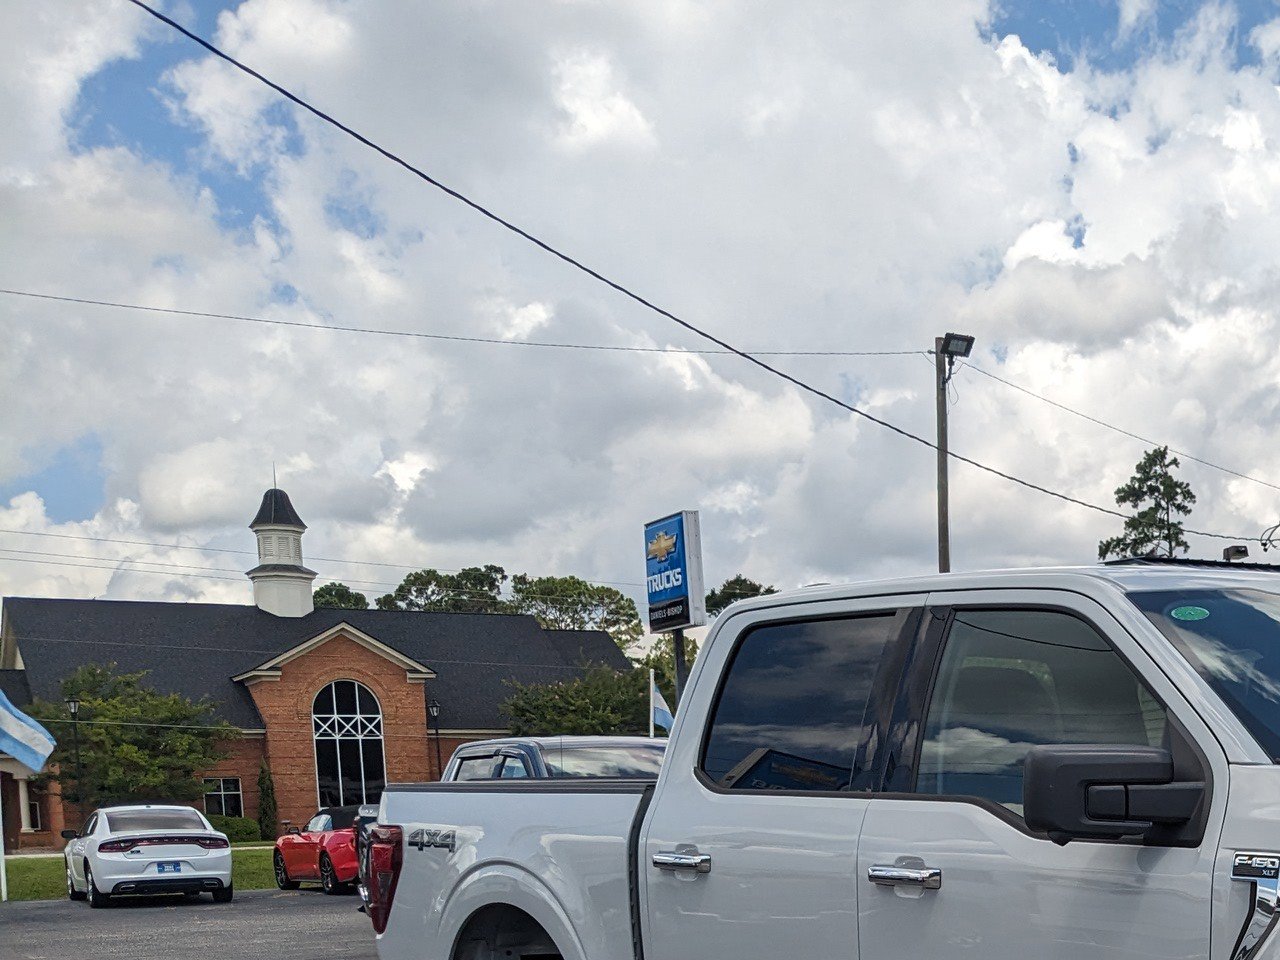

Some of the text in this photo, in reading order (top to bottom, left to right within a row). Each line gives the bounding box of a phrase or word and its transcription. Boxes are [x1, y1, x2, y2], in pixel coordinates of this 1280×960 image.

[647, 567, 683, 594] TRUCKS
[1234, 856, 1280, 869] F-150
[1261, 869, 1276, 877] XLT
